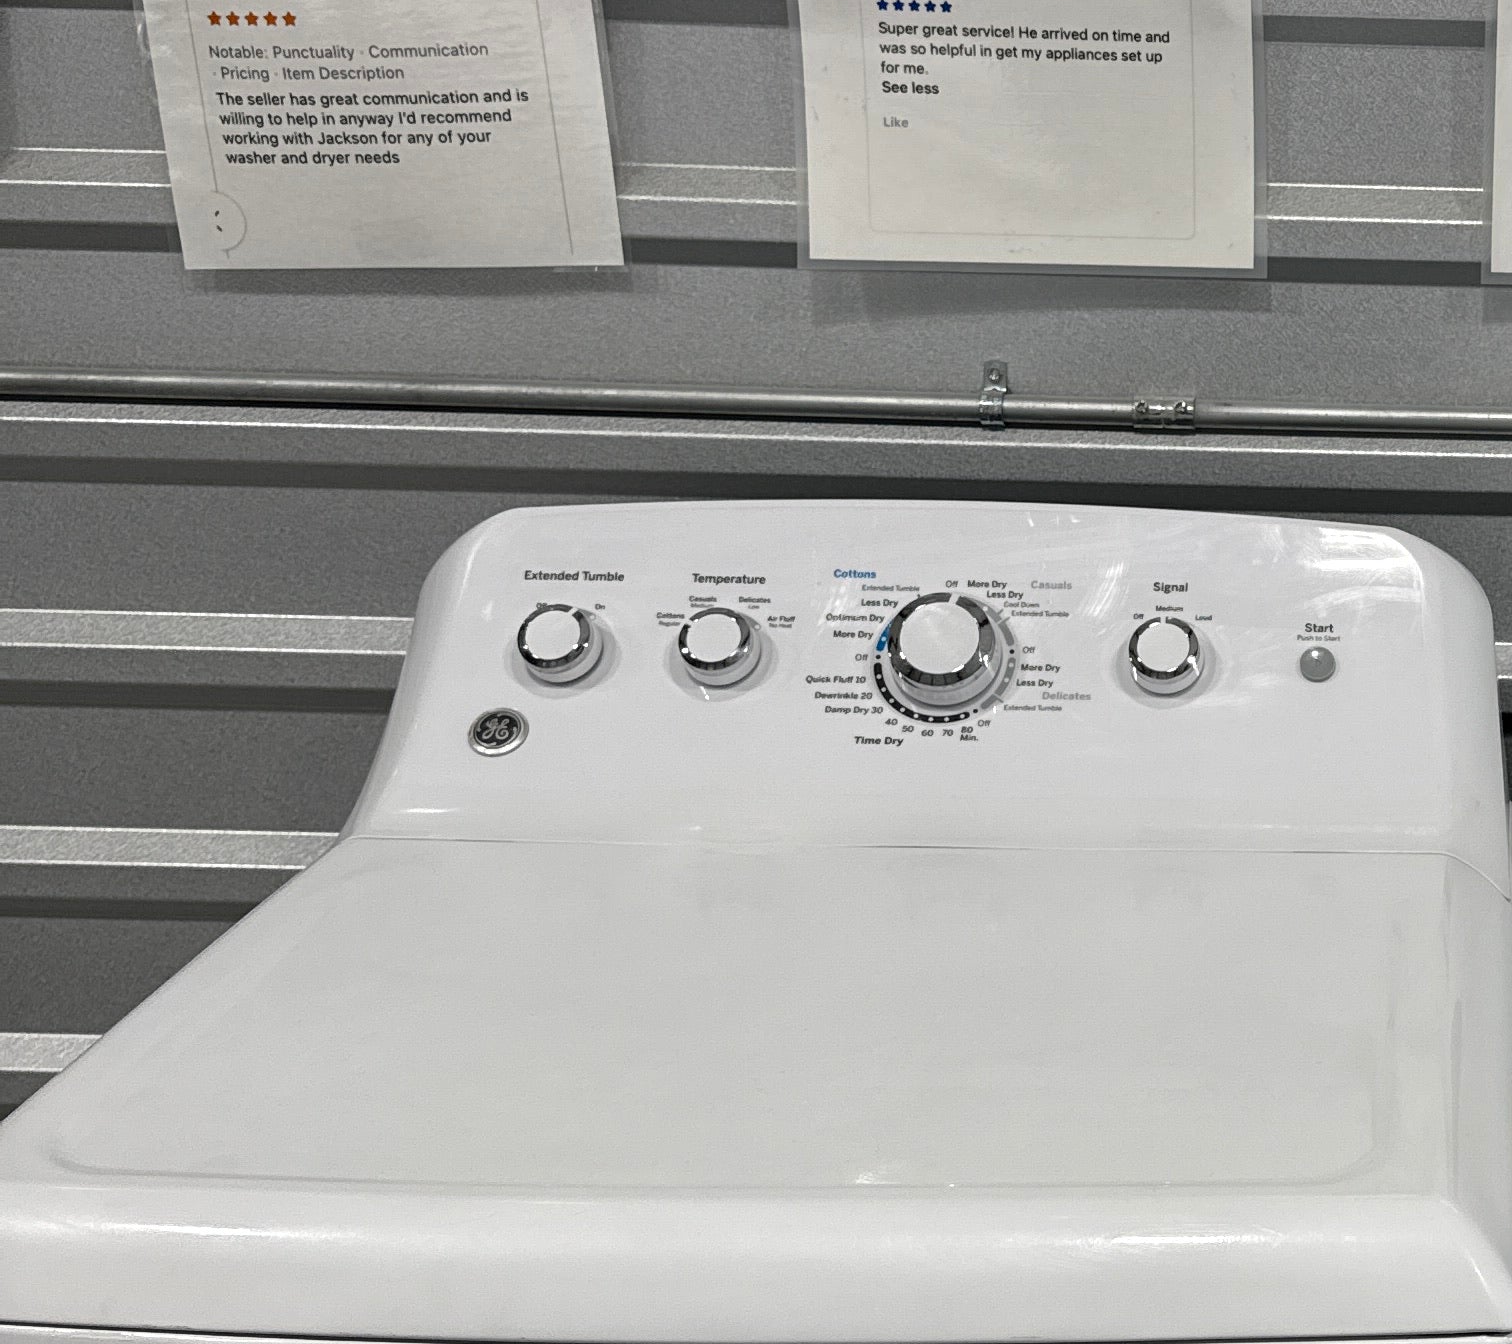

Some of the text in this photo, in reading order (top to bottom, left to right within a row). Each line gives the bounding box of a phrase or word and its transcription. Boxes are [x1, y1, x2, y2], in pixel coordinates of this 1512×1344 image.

[881, 80, 940, 95] See less
[225, 150, 401, 167] washer and dryer needs
[524, 569, 625, 582] Extended Tumble
[691, 572, 766, 586] Temperature
[833, 568, 877, 579] Cottons
[945, 579, 959, 589] Off
[967, 579, 1008, 590] More Dry
[1153, 581, 1189, 595] Signal
[860, 598, 899, 609] Less Dry
[1304, 622, 1334, 634] Start
[833, 629, 874, 641] More Dry
[824, 705, 884, 716] Damp Dry 30
[884, 718, 898, 726] 40
[901, 725, 915, 733] 50
[920, 729, 935, 737] 60
[942, 728, 954, 737] 70
[854, 735, 904, 747] Time Dry
